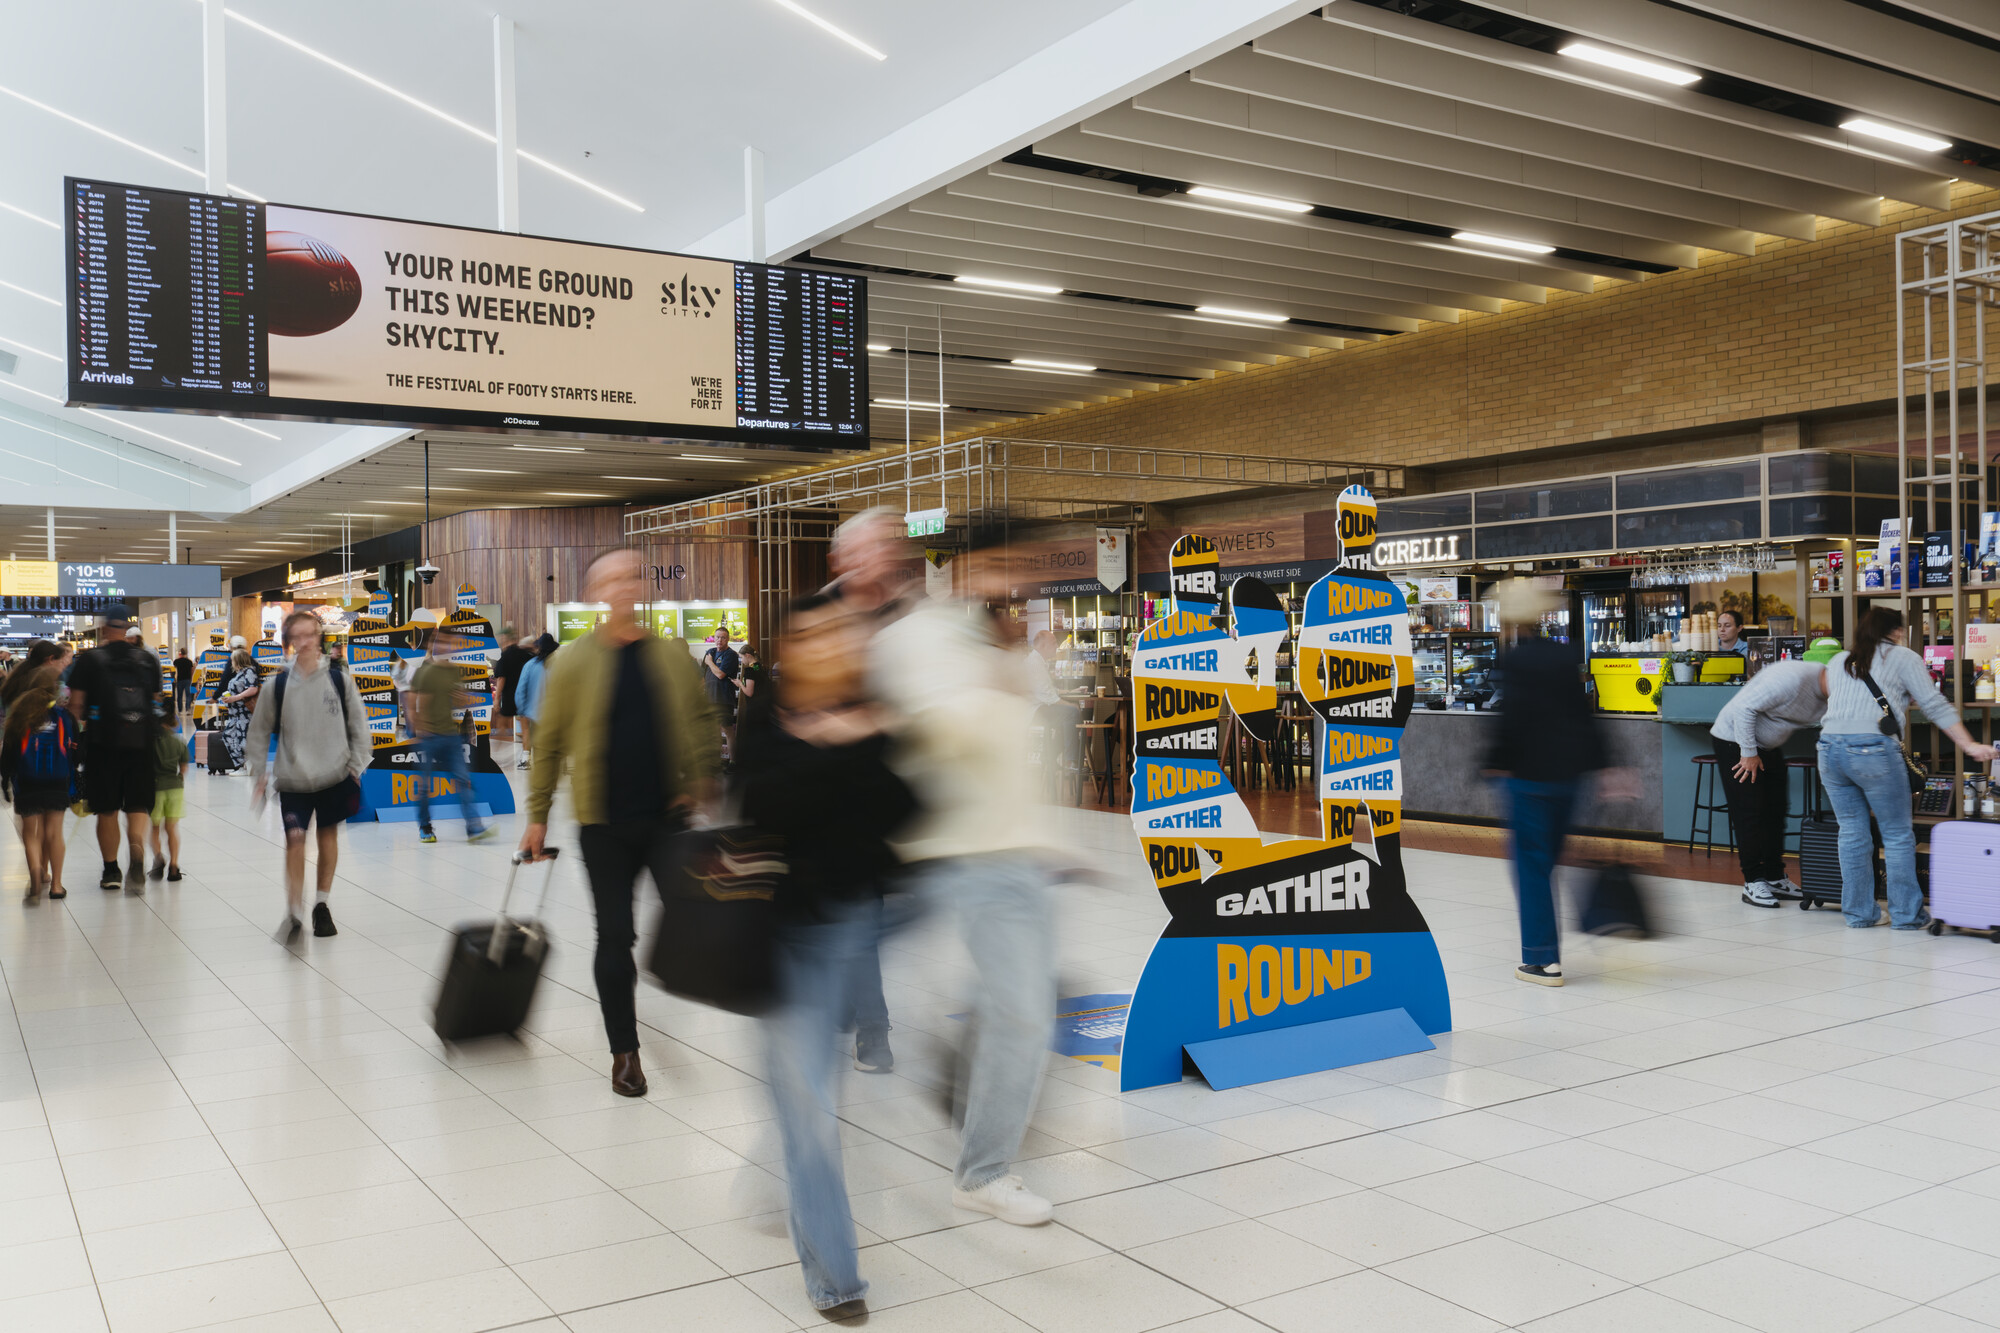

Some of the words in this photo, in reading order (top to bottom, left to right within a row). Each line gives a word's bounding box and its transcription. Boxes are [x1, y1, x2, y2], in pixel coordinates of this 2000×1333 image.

[384, 251, 453, 282] YOUR
[461, 260, 531, 290] HOME
[539, 269, 633, 300] GROUND
[385, 287, 450, 316] THIS
[457, 294, 595, 329] WEEKEND?
[661, 307, 700, 318] CITY
[386, 322, 504, 356] SKYCITY.
[81, 370, 134, 384] Arrivals
[386, 374, 413, 388] THE
[417, 376, 484, 394] FESTIVAL
[488, 381, 504, 395] OF
[508, 383, 548, 399] FOOTY
[551, 387, 598, 402] STARTS
[601, 390, 636, 404] HERE.
[697, 388, 722, 399] HERE
[690, 398, 709, 410] FOR
[711, 400, 722, 410] IT
[503, 417, 540, 426] JCDecaux
[737, 417, 789, 429] Departures
[1210, 531, 1275, 552] SWEETS
[1375, 535, 1460, 565] CIRELLI
[1927, 545, 1941, 556] SIP
[1942, 545, 1949, 556] A
[1050, 551, 1086, 568] FOOD
[76, 565, 114, 578] 10-16
[1263, 569, 1284, 578] SWEET
[1286, 568, 1301, 576] SIDE
[1077, 583, 1101, 591] PRODUCE
[1328, 580, 1392, 616] ROUND
[353, 620, 389, 632] ROUND
[451, 625, 484, 633] GATHER
[1329, 624, 1392, 645] GATHER
[353, 635, 389, 644] GATHER
[354, 648, 390, 661] ROUND
[451, 653, 485, 661] GATHER
[1145, 649, 1218, 672] GATHER
[355, 663, 390, 673] GATHER
[458, 666, 485, 677] OUND
[1329, 655, 1391, 691] ROUND
[355, 676, 391, 690] ROUND
[464, 681, 486, 690] THER
[360, 692, 391, 701] ATHER
[1145, 684, 1219, 722] ROUND
[364, 706, 392, 717] OUND
[1329, 696, 1393, 718] GATHER
[1146, 726, 1217, 750] GATHER
[391, 743, 471, 763] GATR
[1330, 730, 1393, 765] ROUND
[392, 773, 471, 804] ROUN
[1147, 764, 1221, 802] ROUND
[1330, 769, 1394, 791] GATHER
[1148, 805, 1222, 829] GATHER
[1331, 804, 1394, 840] ROND
[1216, 859, 1370, 916] GATHER
[1217, 943, 1372, 1029] ROUND
